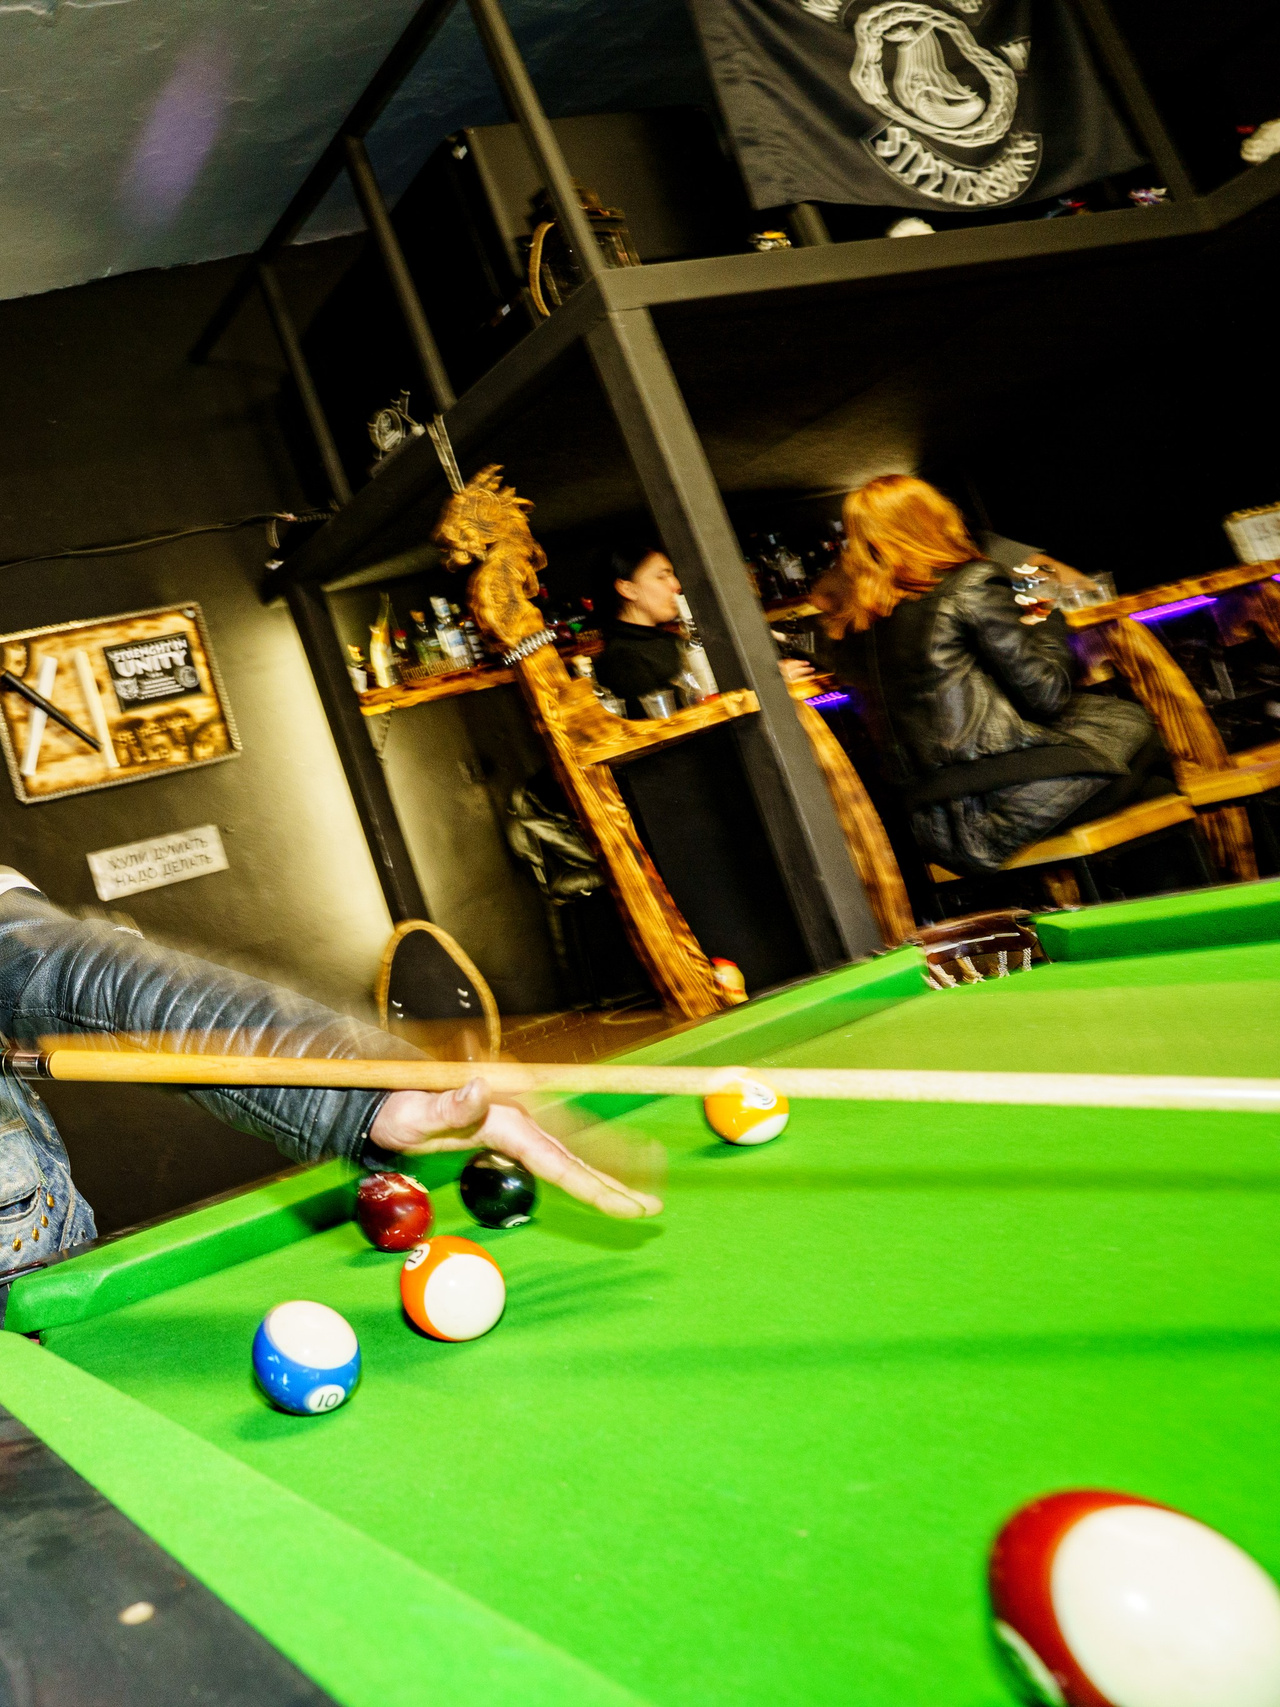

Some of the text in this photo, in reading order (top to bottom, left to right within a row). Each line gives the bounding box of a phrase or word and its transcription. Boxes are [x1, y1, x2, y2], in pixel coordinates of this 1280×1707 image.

[114, 649, 187, 677] UNITY
[154, 838, 208, 860] ДУМАТЬ
[115, 854, 213, 887] НАДО ДЕЛАТЬ
[318, 1393, 338, 1407] 10
